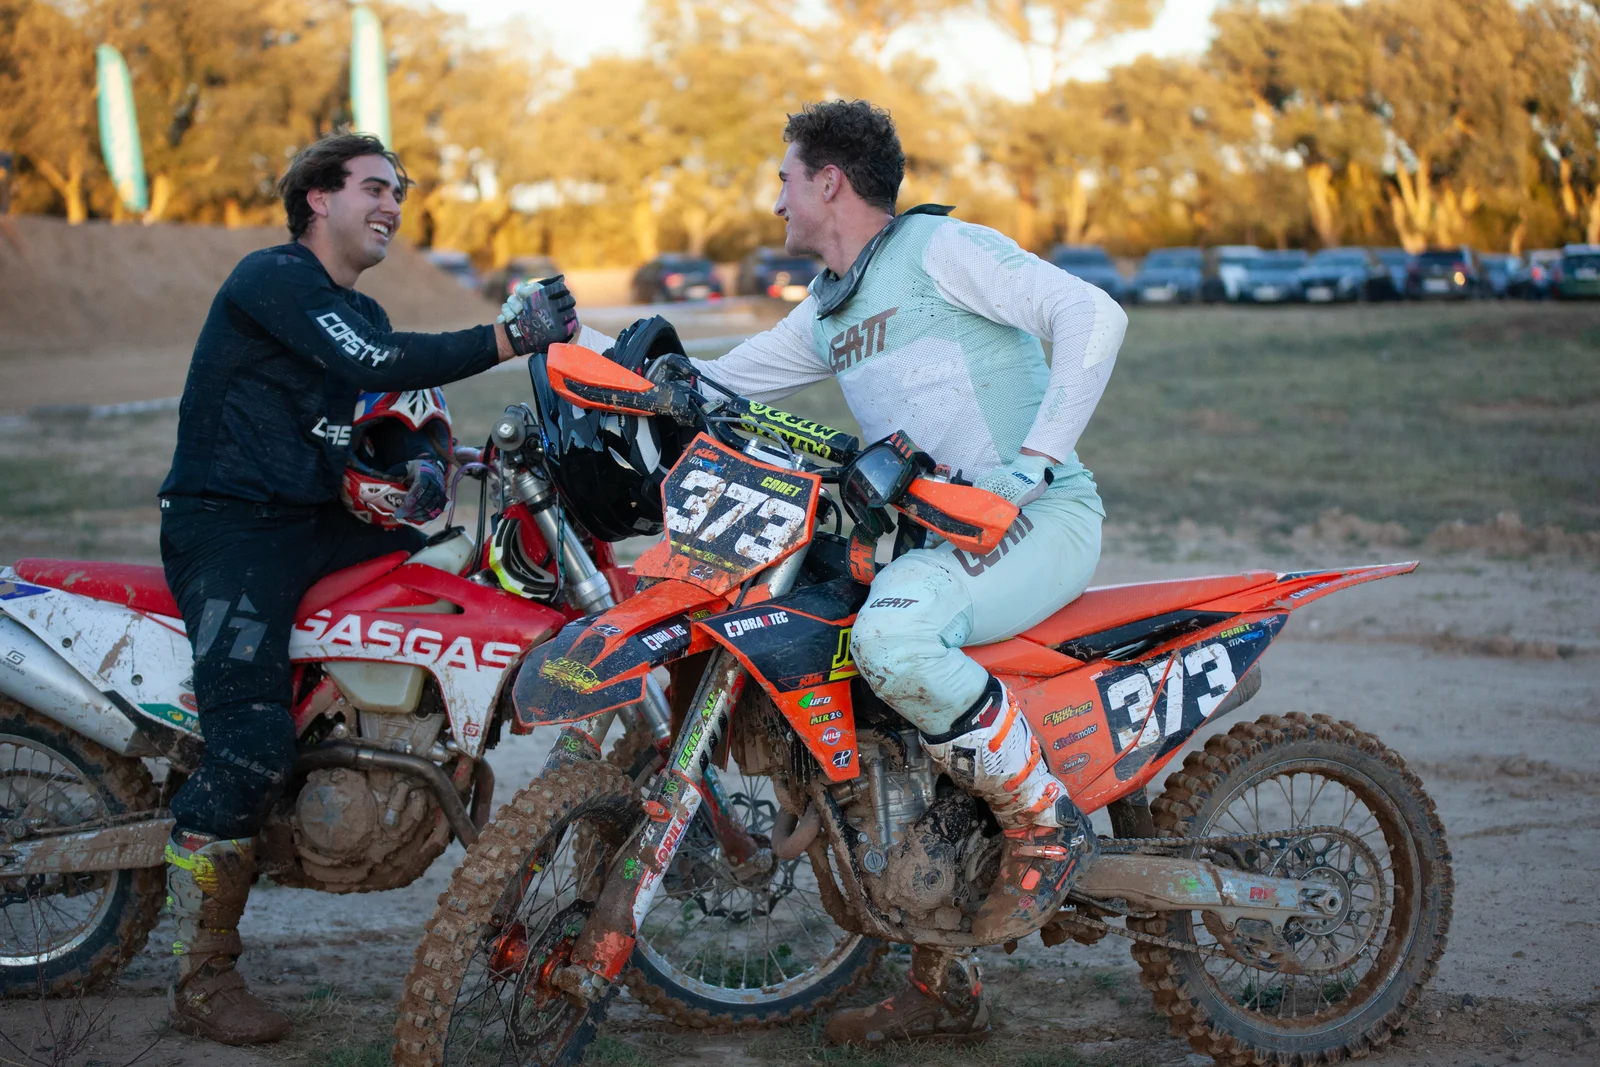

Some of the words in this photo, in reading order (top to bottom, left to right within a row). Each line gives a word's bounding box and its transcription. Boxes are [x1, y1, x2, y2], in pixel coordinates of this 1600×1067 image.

[316, 312, 390, 367] COASTY
[1012, 471, 1036, 485] LEATT
[760, 476, 803, 497] CANET
[665, 469, 806, 565] 373
[869, 598, 919, 608] LEATT
[1220, 623, 1250, 639] CANET
[293, 608, 521, 673] GASGAS
[799, 674, 824, 688] KTM
[808, 696, 832, 707] UFO
[1107, 643, 1237, 753] 373
[821, 730, 842, 743] NILS
[1063, 759, 1077, 770] Twin
[1077, 756, 1086, 765] Air
